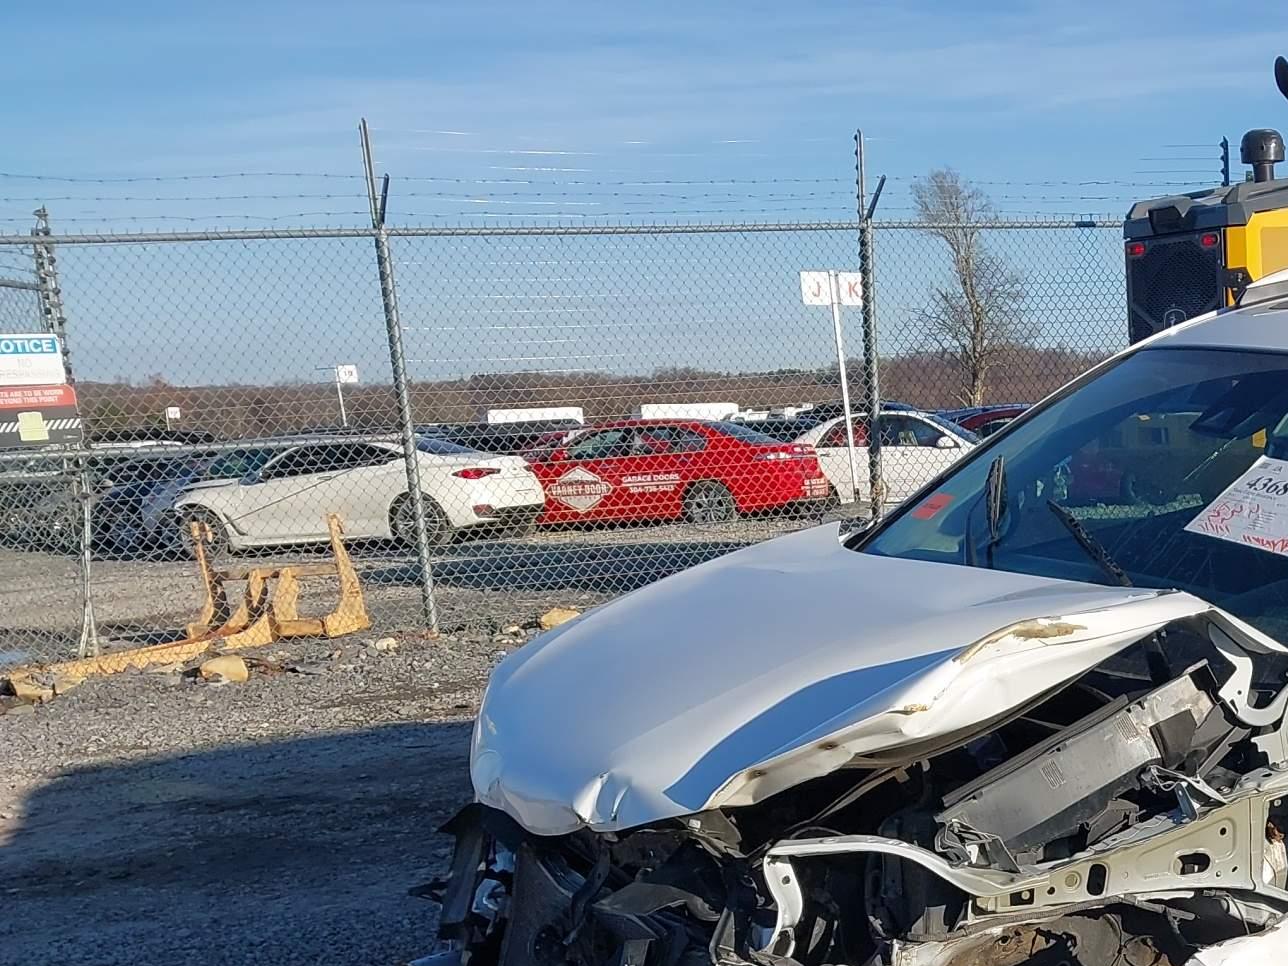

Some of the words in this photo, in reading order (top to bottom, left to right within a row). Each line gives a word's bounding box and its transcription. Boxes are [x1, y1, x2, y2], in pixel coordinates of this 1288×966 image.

[812, 281, 821, 298] J
[847, 281, 860, 298] K
[0, 338, 54, 353] OTICE
[653, 473, 680, 481] DOORS
[585, 483, 608, 493] DOOR
